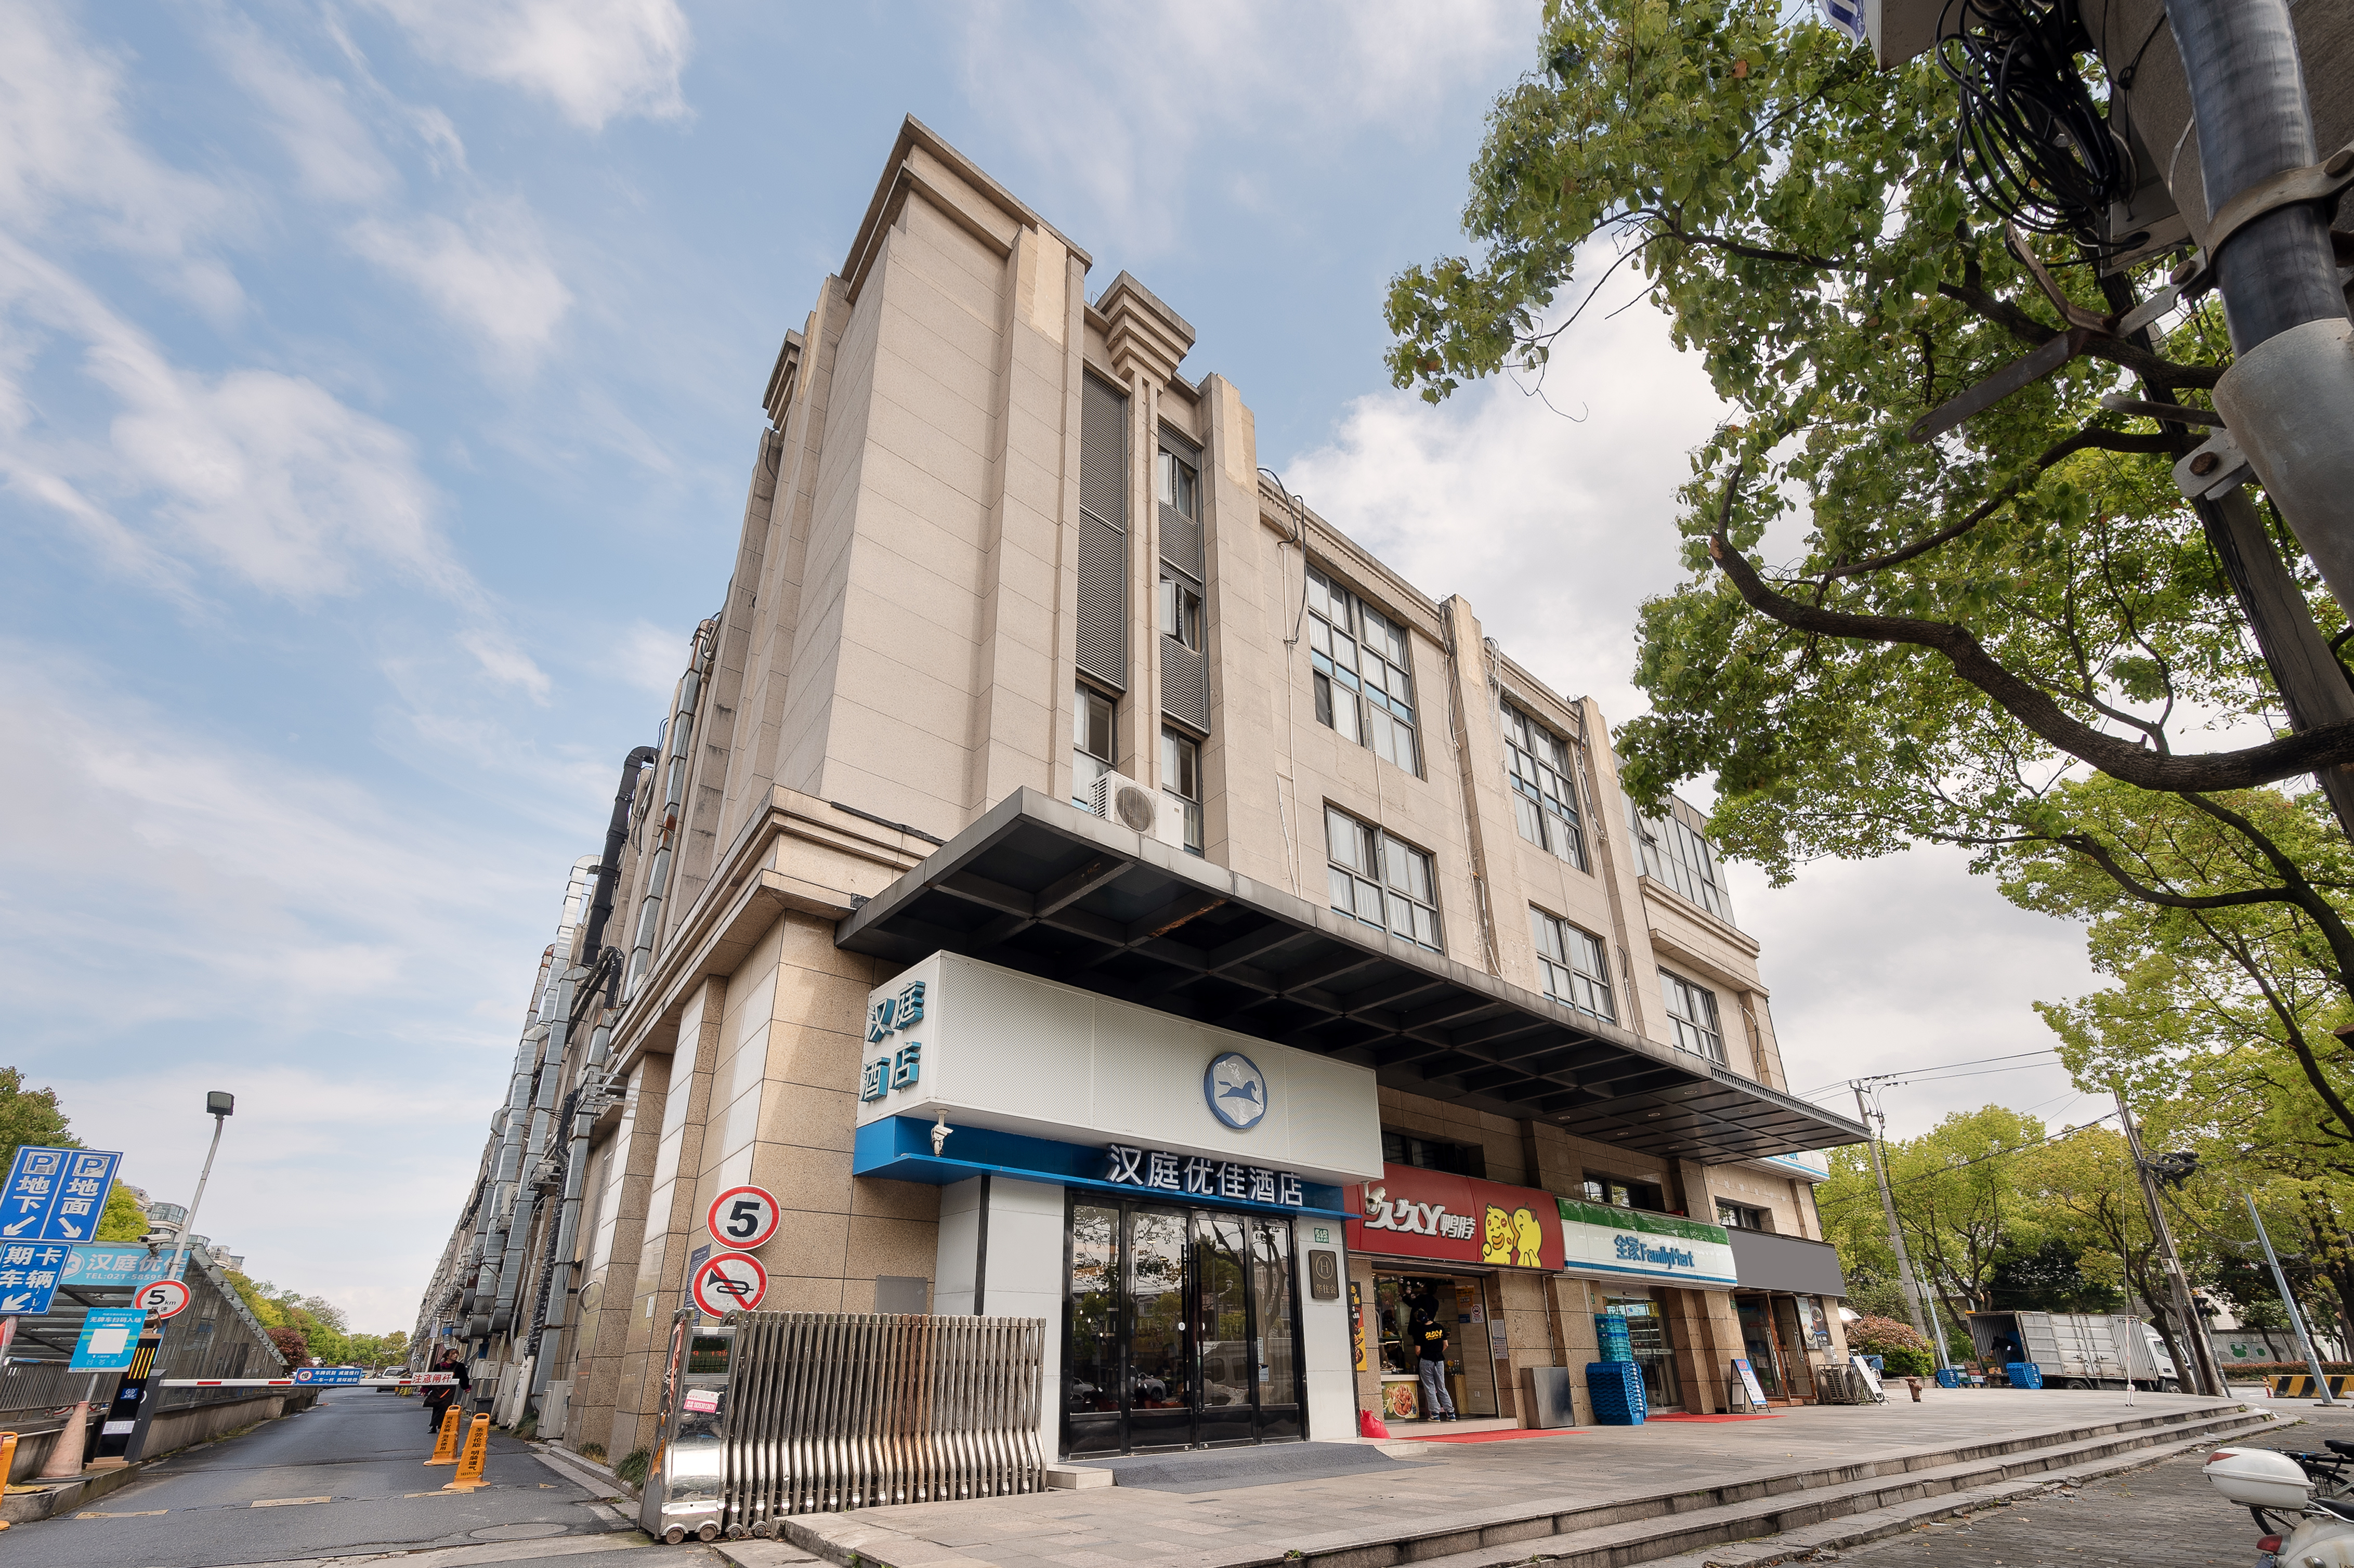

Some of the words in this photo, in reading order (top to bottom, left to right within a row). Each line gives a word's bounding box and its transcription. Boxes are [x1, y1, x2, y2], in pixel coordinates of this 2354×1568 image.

[867, 981, 925, 1043] 汉庭
[859, 1041, 922, 1103] 酒店
[29, 1155, 54, 1171] P
[79, 1158, 102, 1173] P
[1104, 1144, 1303, 1207] 汉庭优佳酒店
[13, 1175, 50, 1213] 地下
[60, 1178, 100, 1216] 地面
[726, 1200, 761, 1238] 5
[3, 1246, 63, 1265] 期卡
[1614, 1234, 1641, 1261] 全家
[1640, 1243, 1695, 1270] FamilyMart
[0, 1269, 57, 1288] 车辆
[1316, 1284, 1336, 1294] 华住会
[412, 1374, 451, 1383] 注意闸杆
